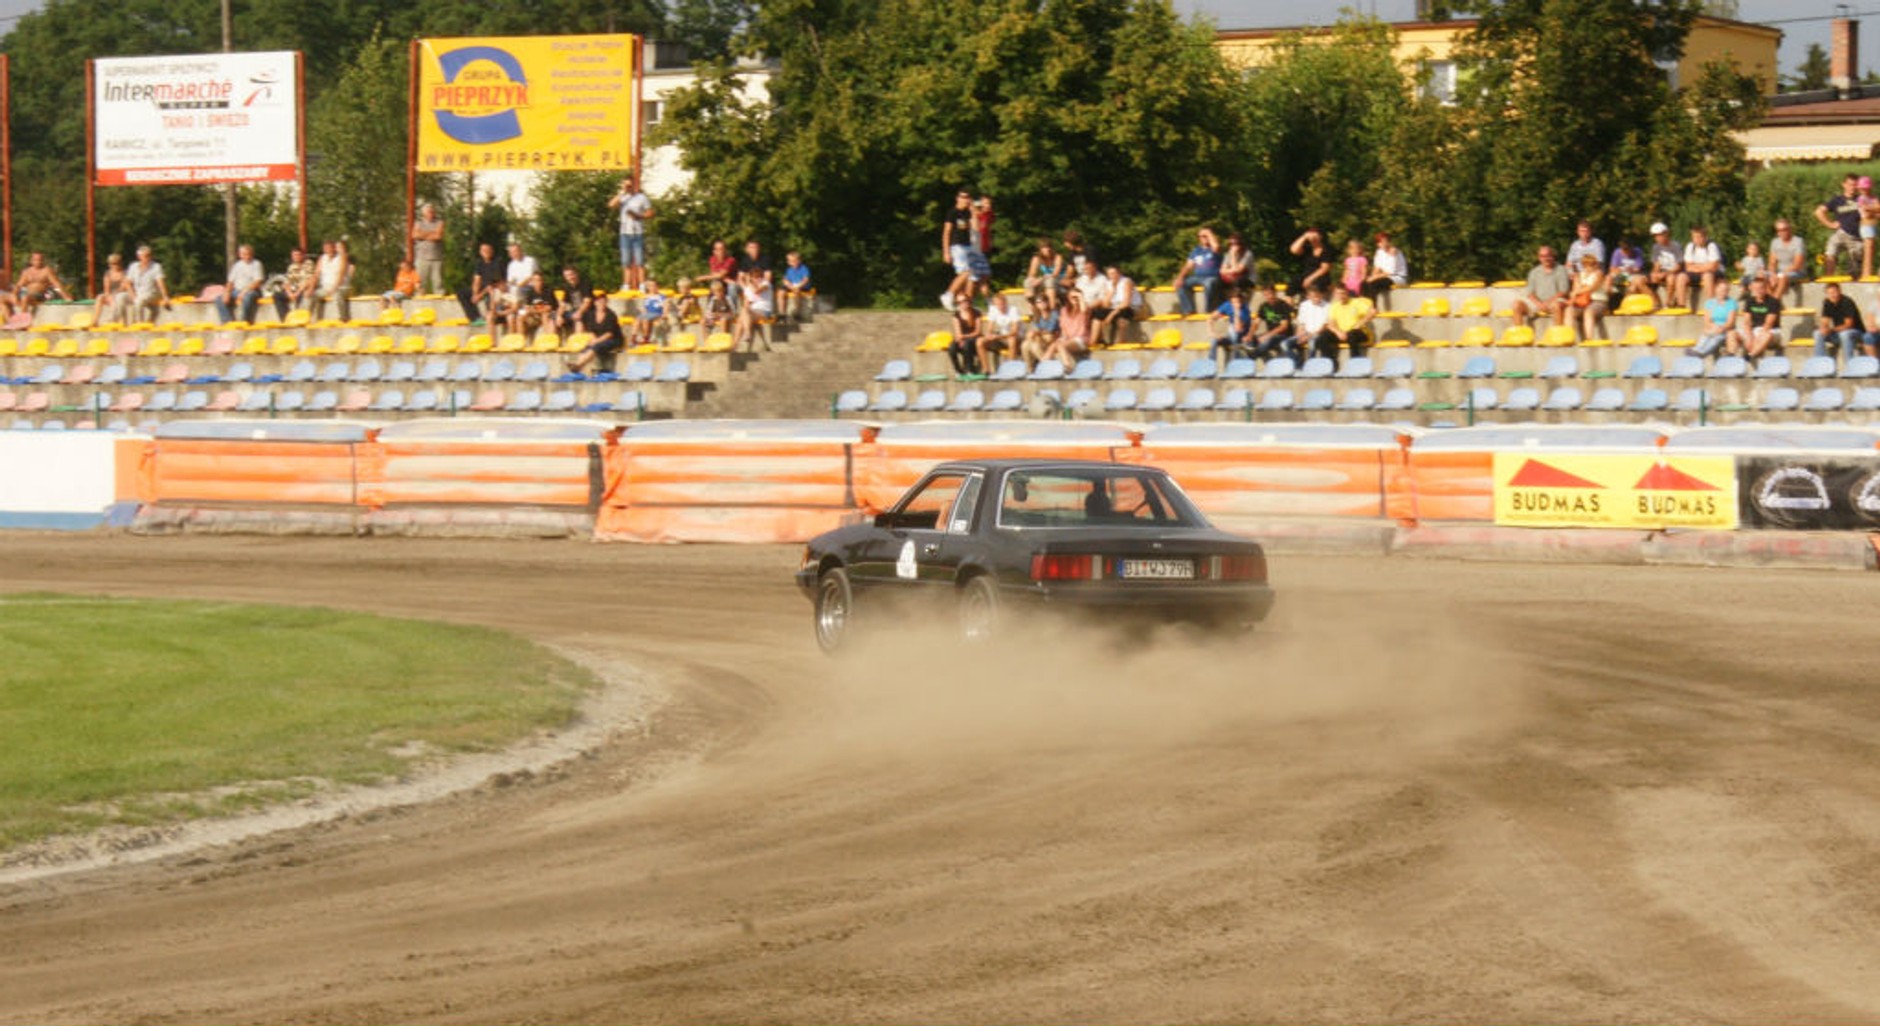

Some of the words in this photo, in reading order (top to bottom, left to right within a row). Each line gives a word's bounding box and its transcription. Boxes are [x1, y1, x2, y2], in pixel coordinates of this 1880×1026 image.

[463, 70, 501, 80] GRUPA
[433, 86, 529, 107] PIEPRZYK
[1512, 492, 1600, 513] BUDMAS
[1638, 495, 1717, 515] BUDMAS
